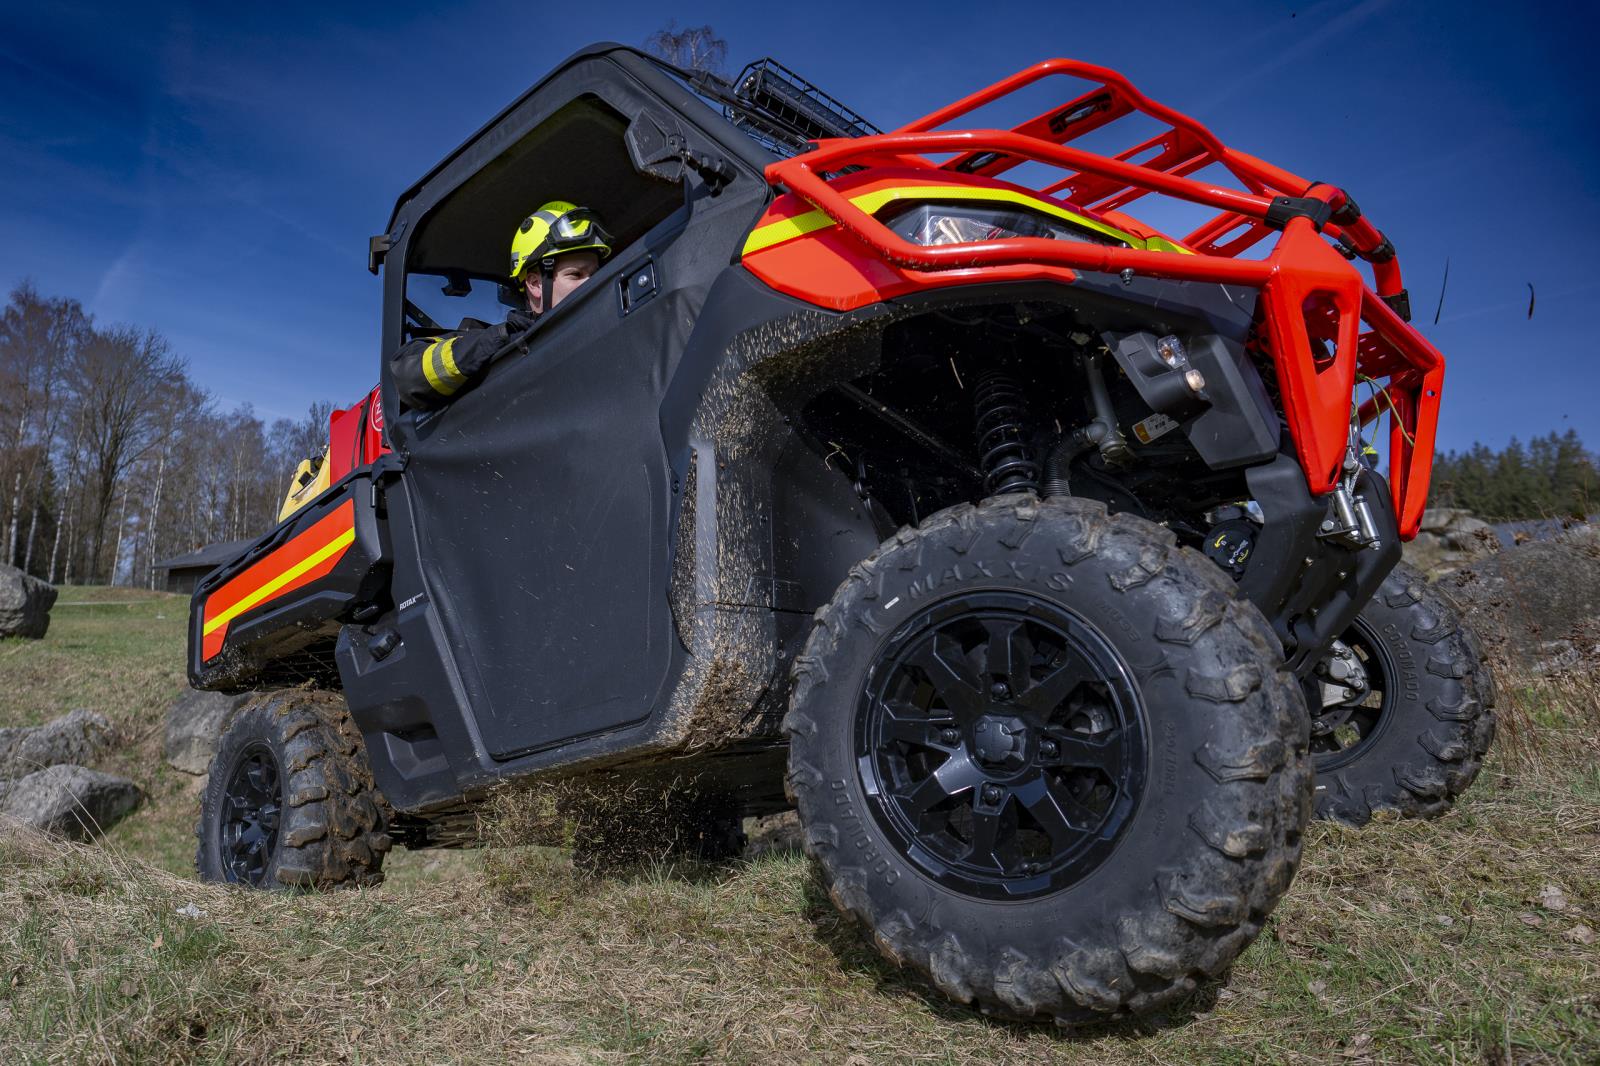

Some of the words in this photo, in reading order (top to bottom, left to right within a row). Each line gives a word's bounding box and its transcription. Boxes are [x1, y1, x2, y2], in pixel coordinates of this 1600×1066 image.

[907, 560, 1073, 599] MAXXIS
[1384, 623, 1419, 701] CORONADO
[831, 778, 901, 886] CORONADO
